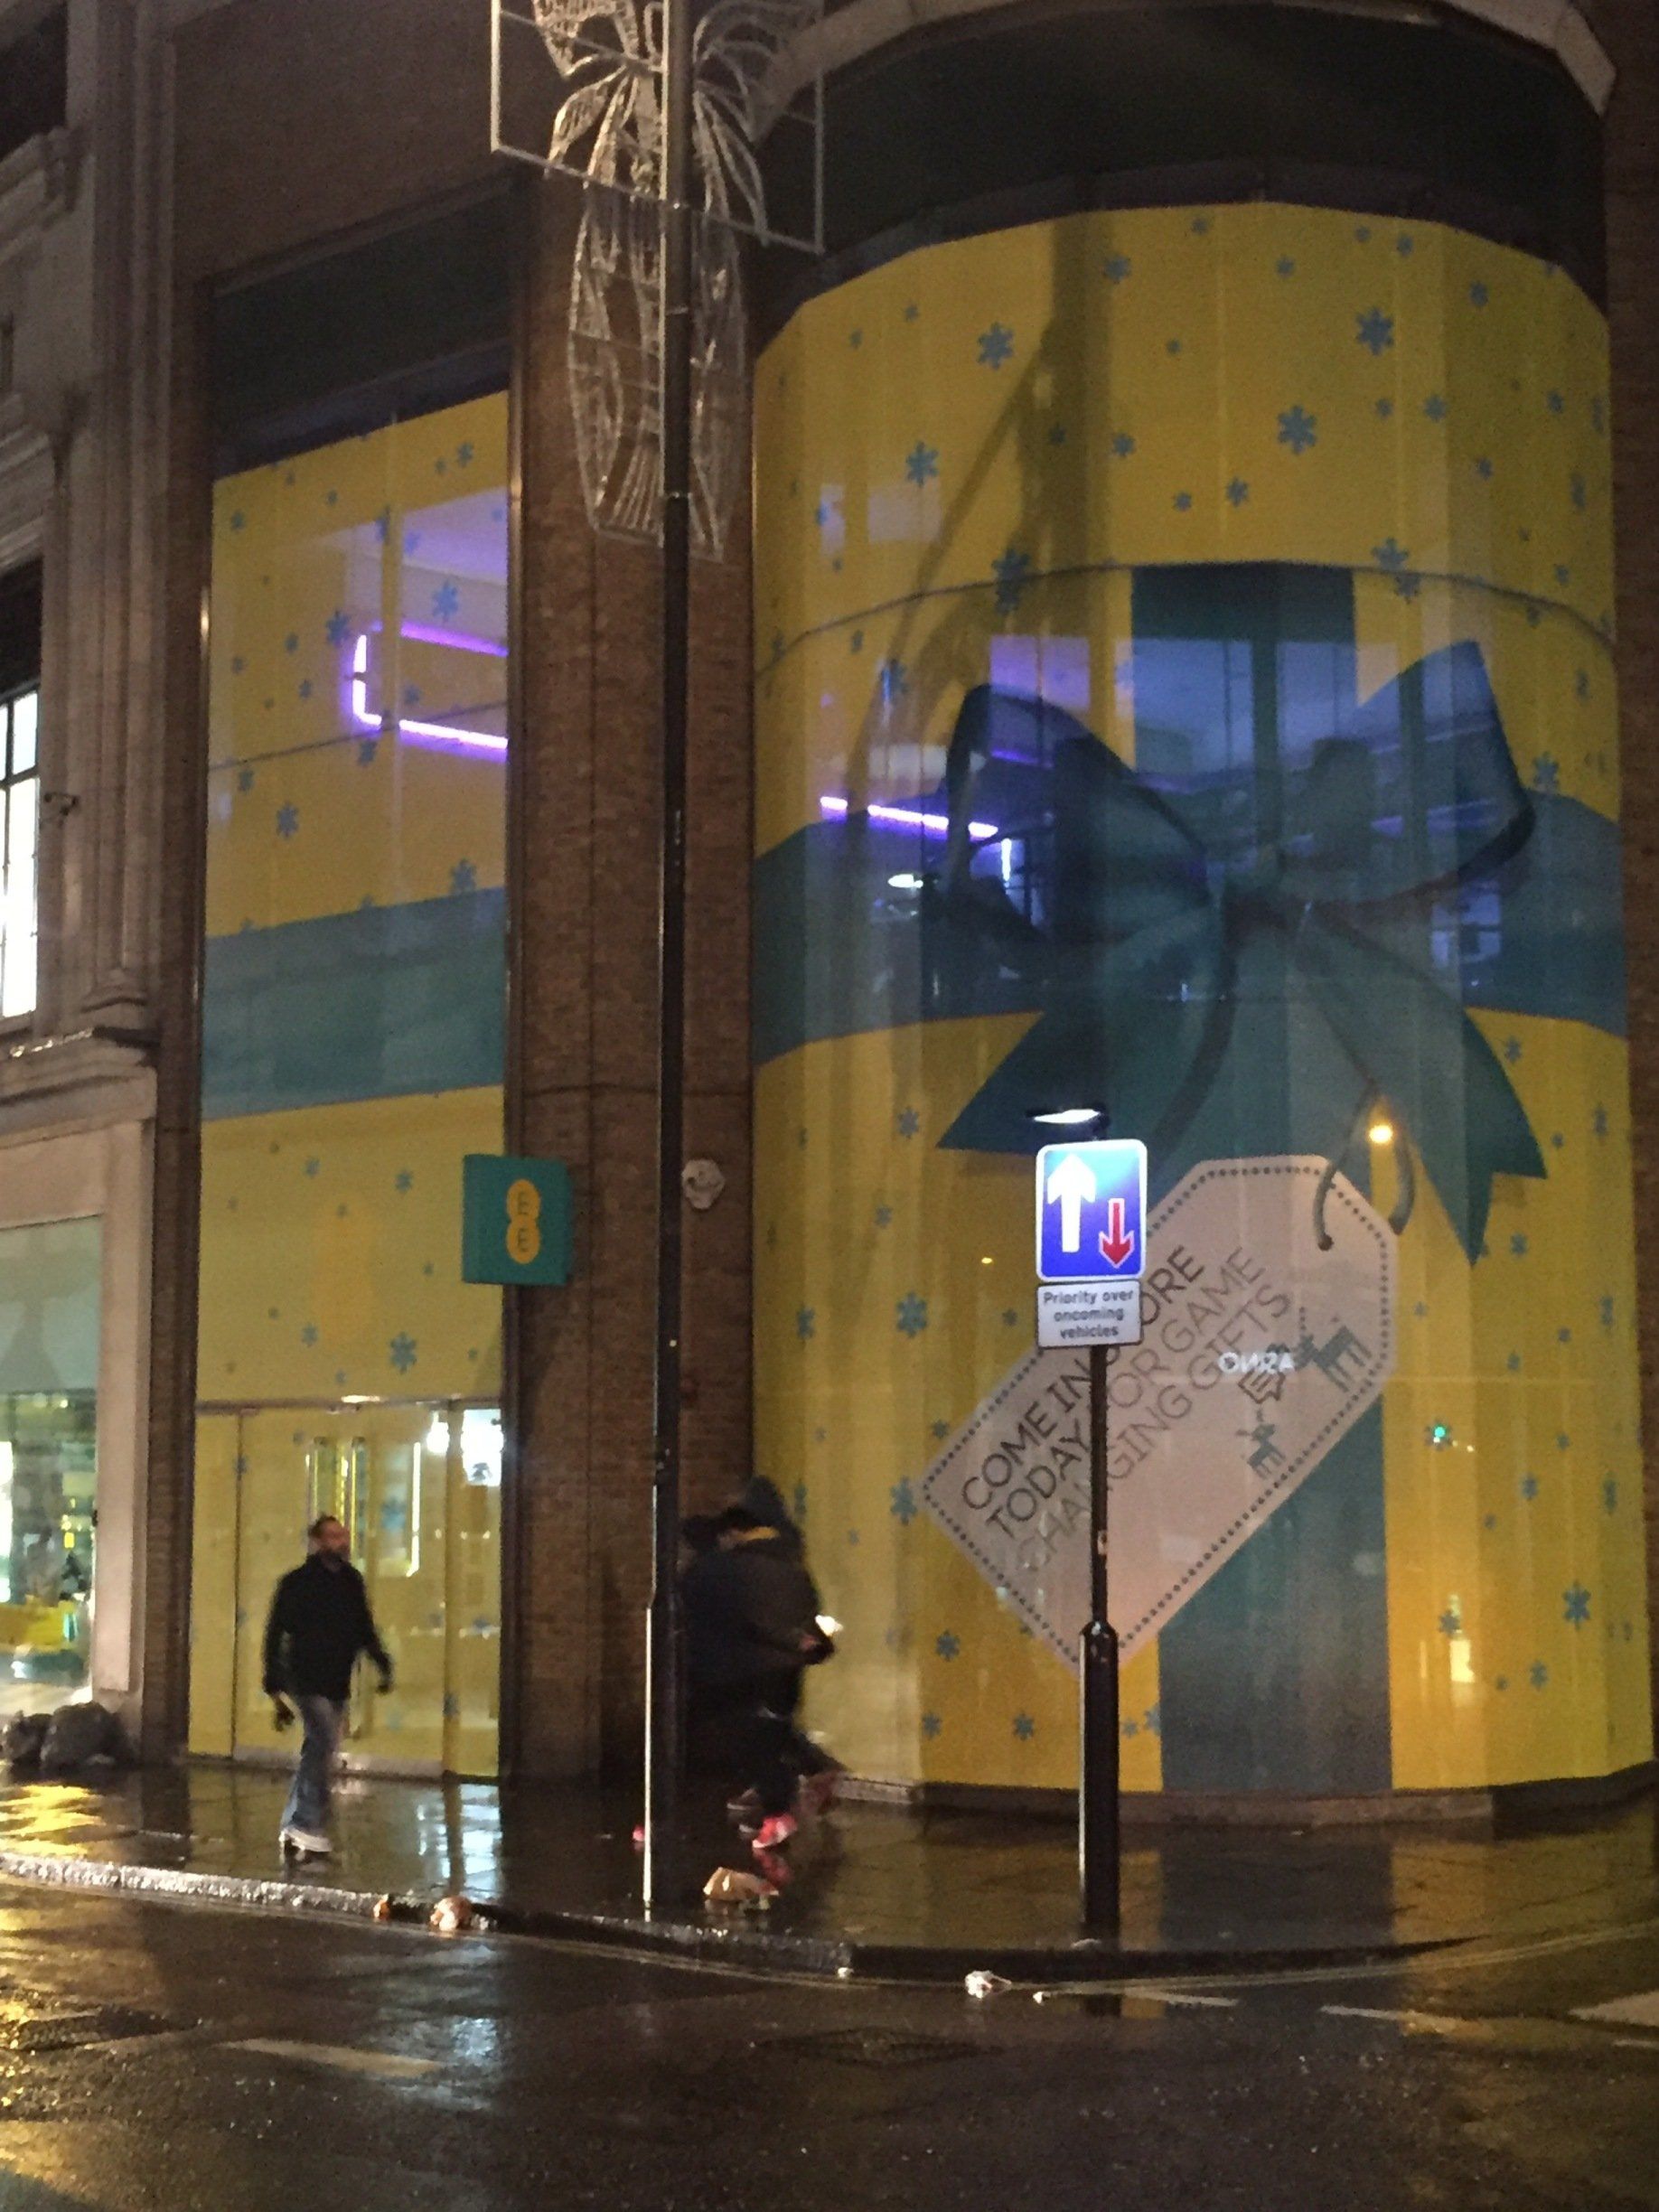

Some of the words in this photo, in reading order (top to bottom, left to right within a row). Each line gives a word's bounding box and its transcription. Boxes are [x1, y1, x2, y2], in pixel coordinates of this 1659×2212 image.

[1044, 1290, 1098, 1305] Priority
[1102, 1290, 1134, 1302] over
[1054, 1308, 1124, 1321] oncoming
[1060, 1325, 1119, 1338] vehicles
[1187, 1284, 1290, 1391] GIFTS
[985, 1418, 1092, 1540] TODAY
[1161, 1246, 1266, 1354] GAME
[961, 1401, 1058, 1510] COME
